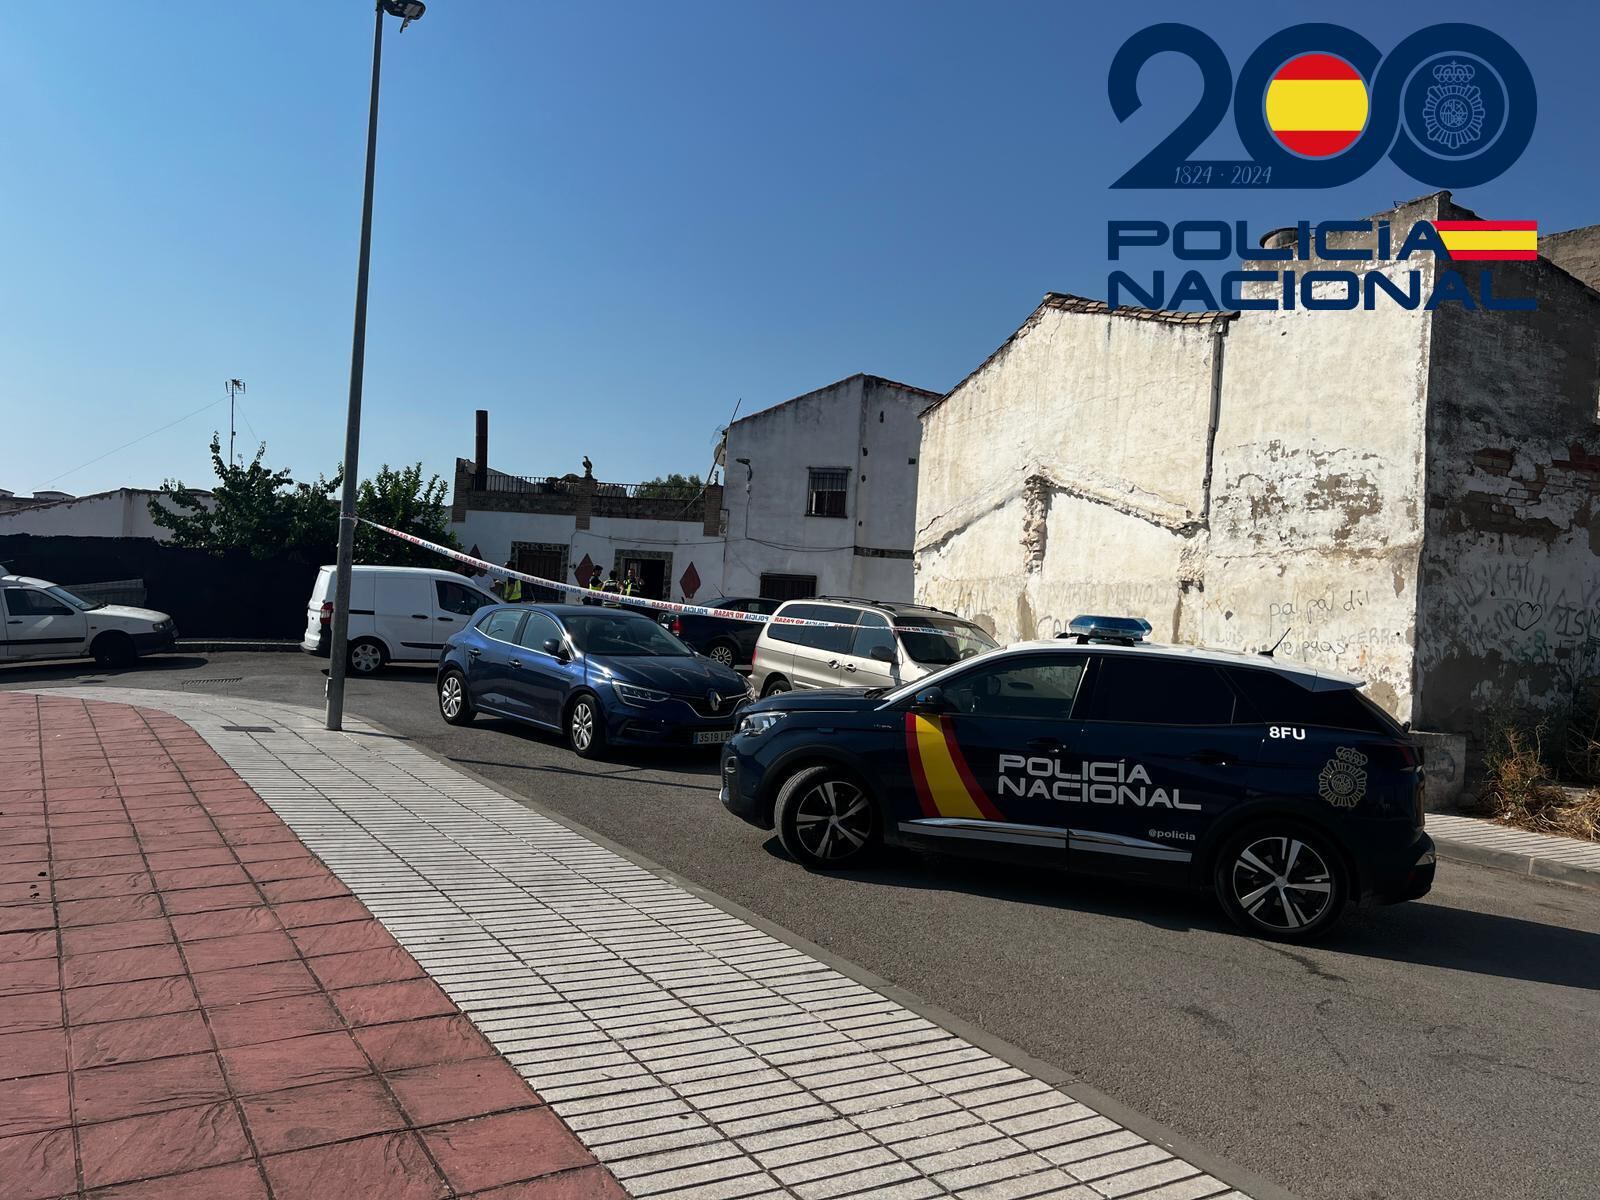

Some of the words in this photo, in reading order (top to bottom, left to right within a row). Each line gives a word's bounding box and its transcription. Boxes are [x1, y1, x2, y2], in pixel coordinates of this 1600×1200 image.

[699, 732, 718, 742] 3519
[1269, 726, 1306, 740] 8FU
[999, 754, 1152, 785] POLICÍA
[998, 775, 1201, 810] NACIONAL
[1149, 828, 1196, 841] @policia
